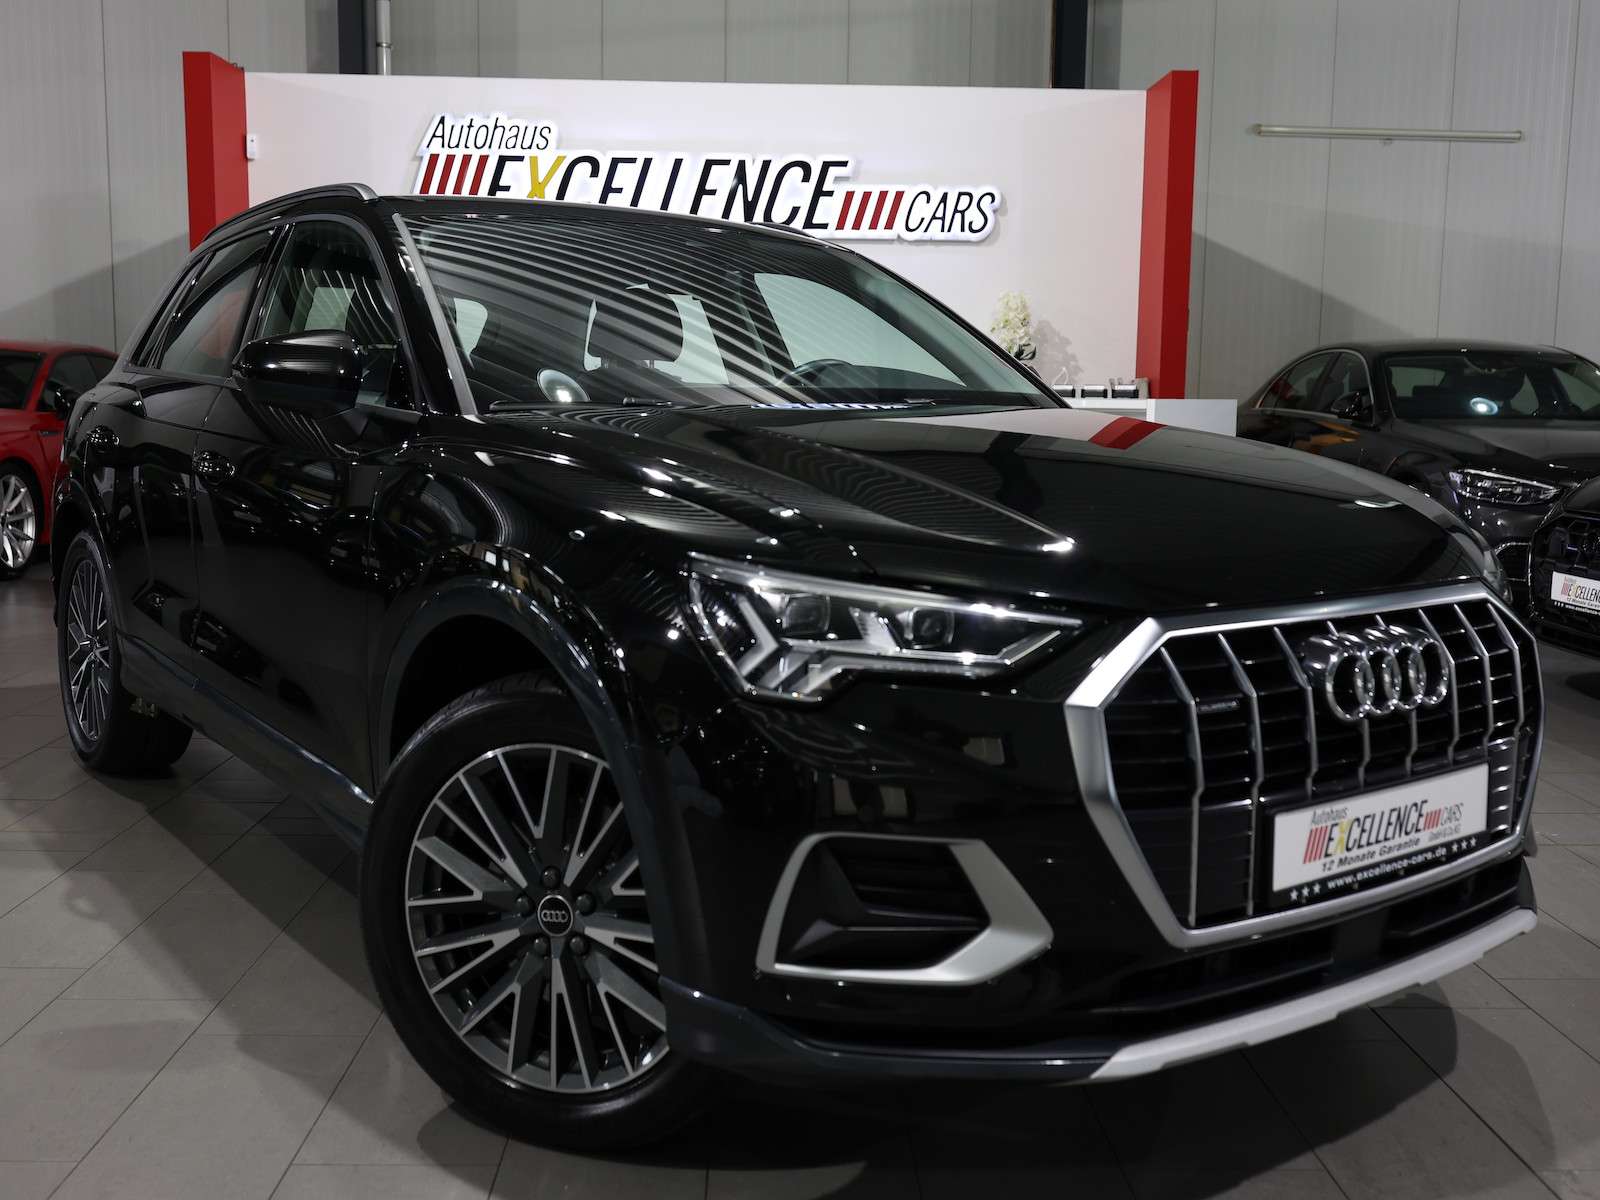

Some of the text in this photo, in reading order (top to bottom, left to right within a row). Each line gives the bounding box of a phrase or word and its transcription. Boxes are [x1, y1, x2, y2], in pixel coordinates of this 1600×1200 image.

[427, 115, 551, 150] Autohaus
[487, 154, 996, 234] EXCELLENCE CARS
[1324, 799, 1428, 858] EXCELLENCE
[1322, 837, 1420, 873] 12 Monate Garantie
[1327, 846, 1447, 890] www.excellence-cars.de
